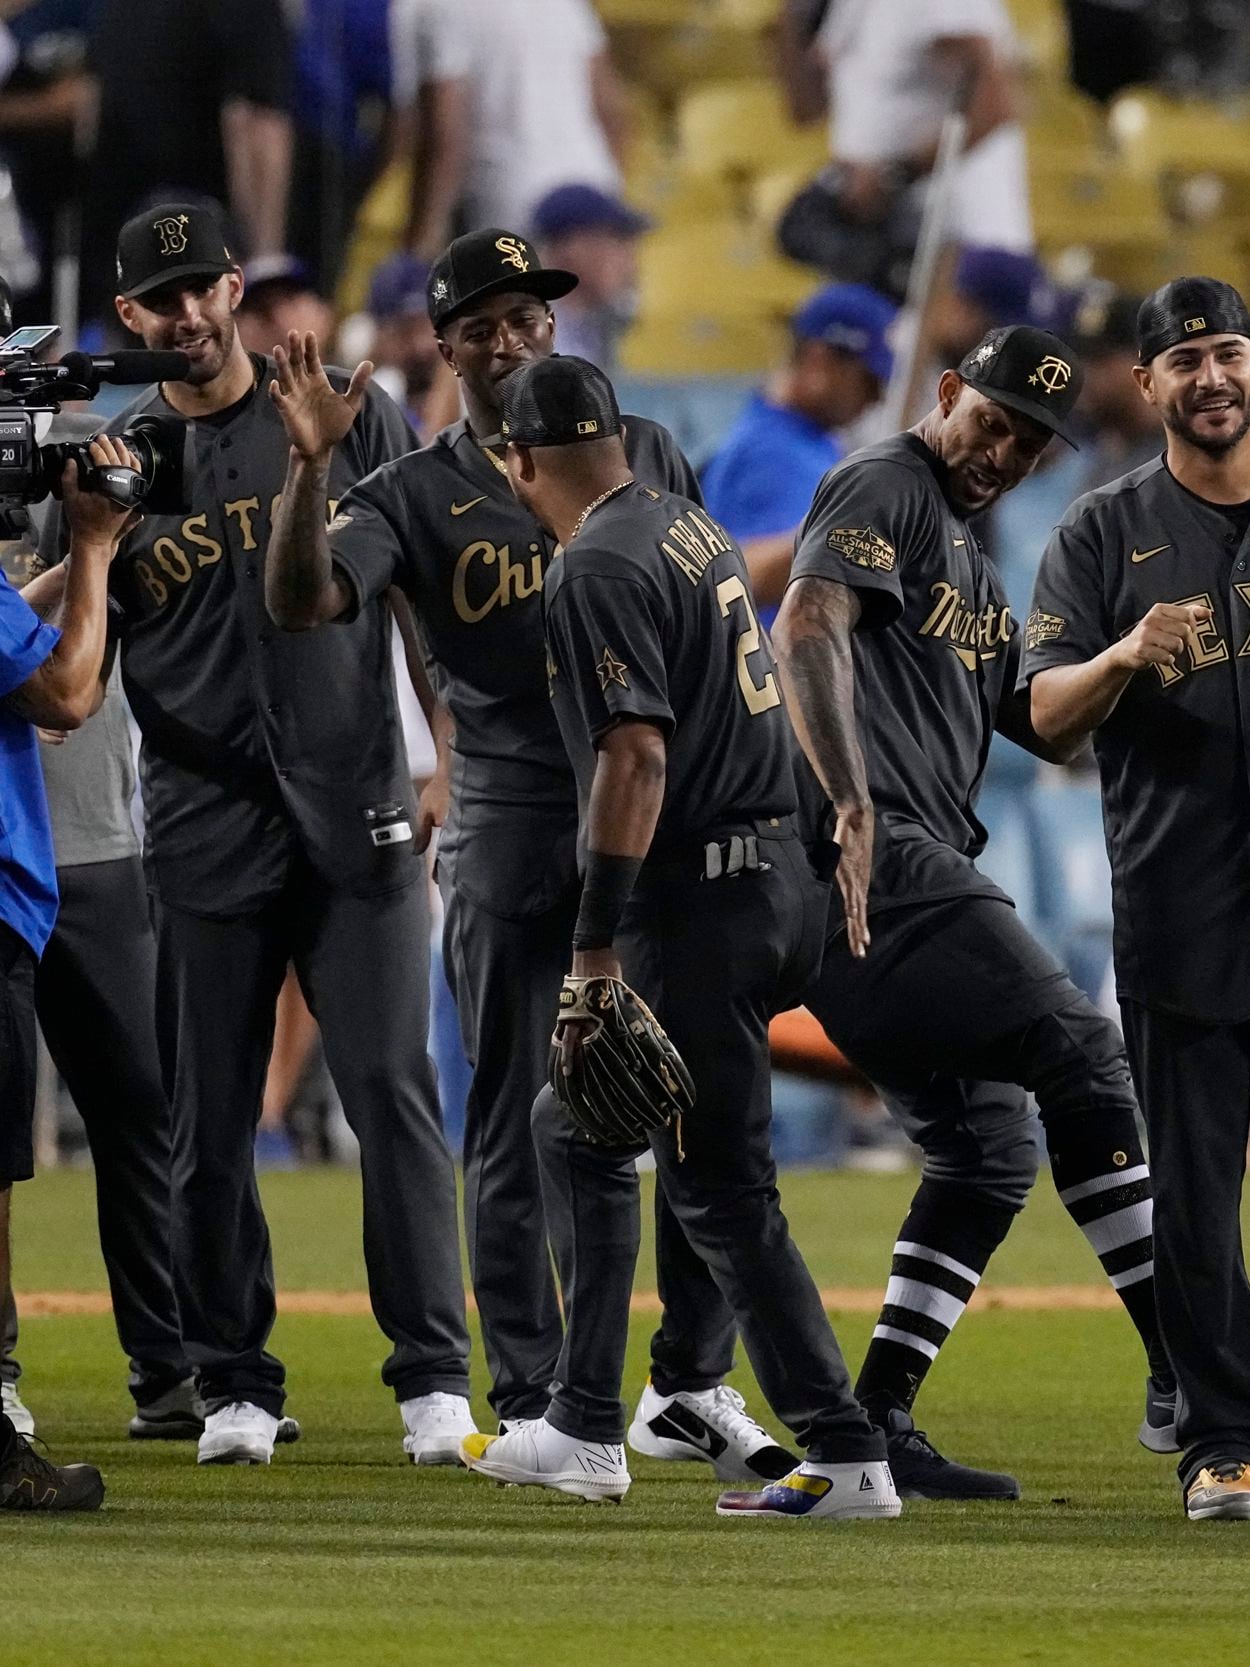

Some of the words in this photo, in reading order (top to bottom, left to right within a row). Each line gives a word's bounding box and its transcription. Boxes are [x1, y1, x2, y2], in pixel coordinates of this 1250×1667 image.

[153, 217, 188, 256] B
[2, 449, 15, 461] 20
[106, 474, 129, 485] Canon
[134, 496, 340, 607] BOST
[871, 545, 895, 566] GAME
[452, 540, 564, 624] Chi
[1038, 622, 1064, 633] GAME
[716, 575, 781, 716] 2
